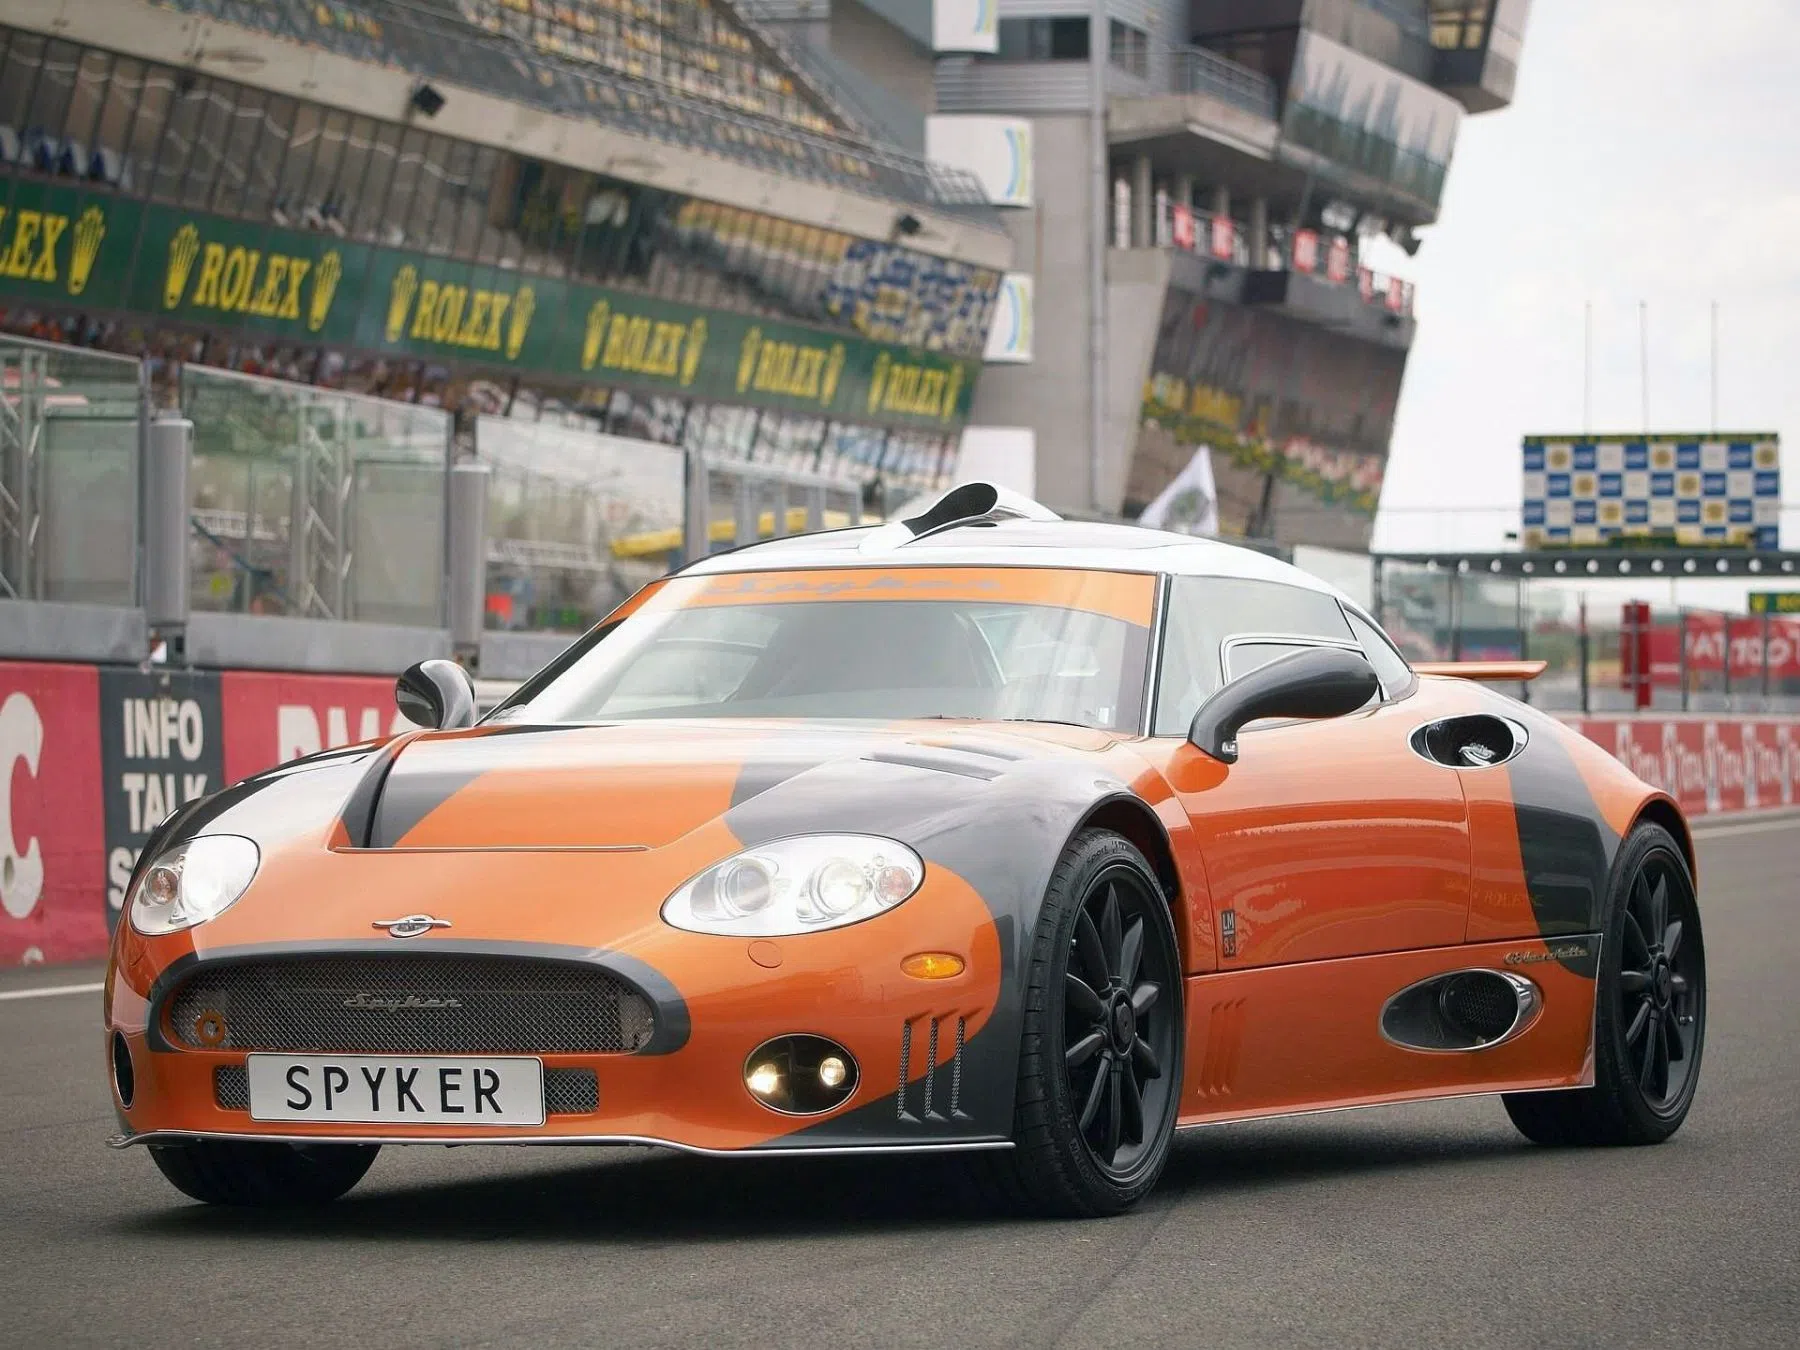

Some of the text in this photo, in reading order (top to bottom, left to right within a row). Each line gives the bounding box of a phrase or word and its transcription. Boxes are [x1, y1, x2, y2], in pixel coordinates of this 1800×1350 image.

[193, 243, 311, 319] ROLEX
[411, 280, 510, 350] ROLEX
[602, 313, 686, 377] ROLEX
[122, 698, 204, 761] INFO
[343, 993, 462, 1013] Spyker
[285, 1064, 504, 1114] SPYKER
